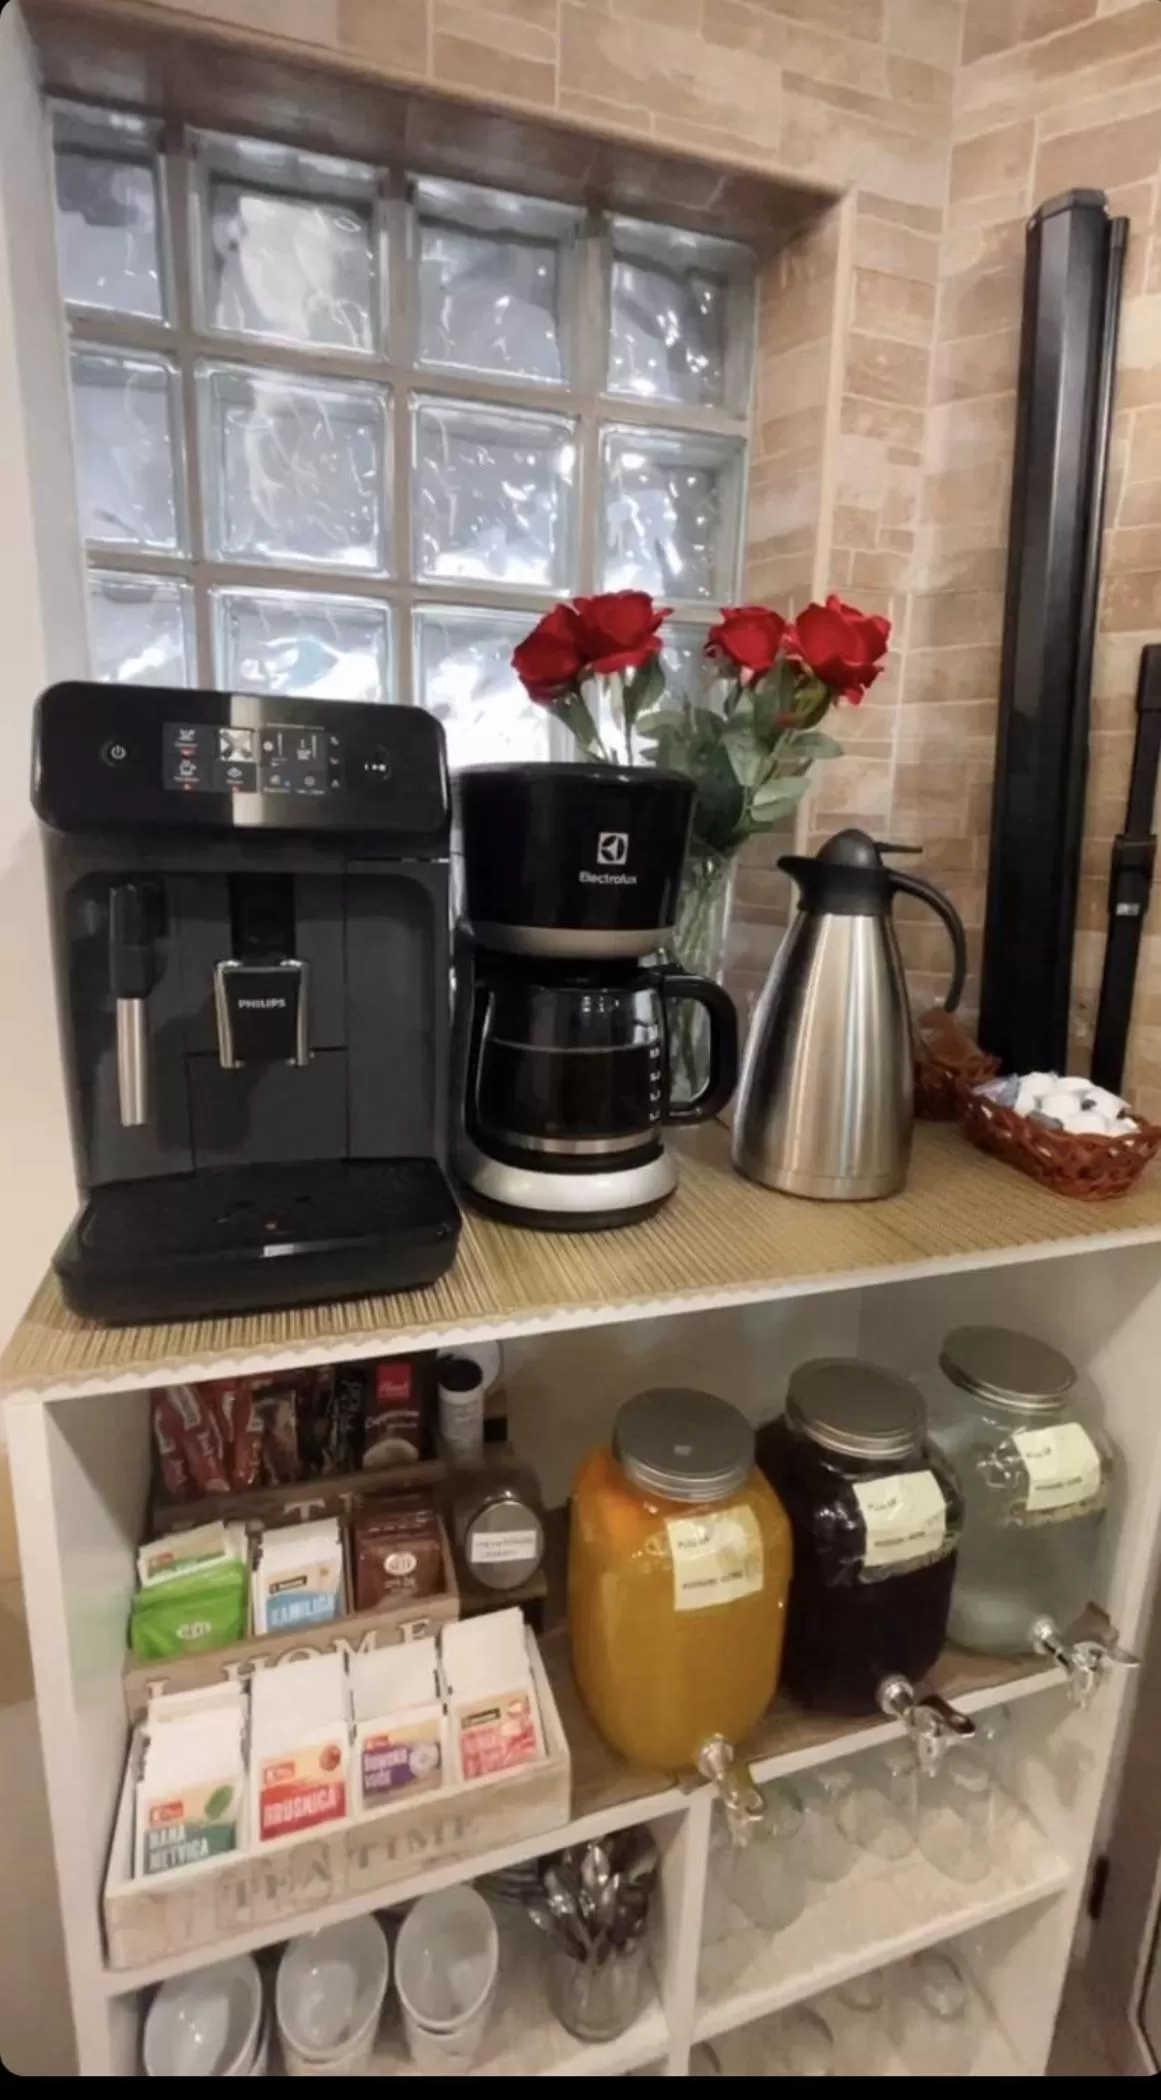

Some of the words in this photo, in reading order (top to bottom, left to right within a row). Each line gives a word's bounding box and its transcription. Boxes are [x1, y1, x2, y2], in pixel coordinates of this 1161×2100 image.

[578, 871, 638, 885] Electrolux
[238, 998, 287, 1009] PHILIPS
[262, 1784, 338, 1827] BRUSNICA
[220, 1846, 336, 1908] TEA
[348, 1814, 478, 1870] TIME
